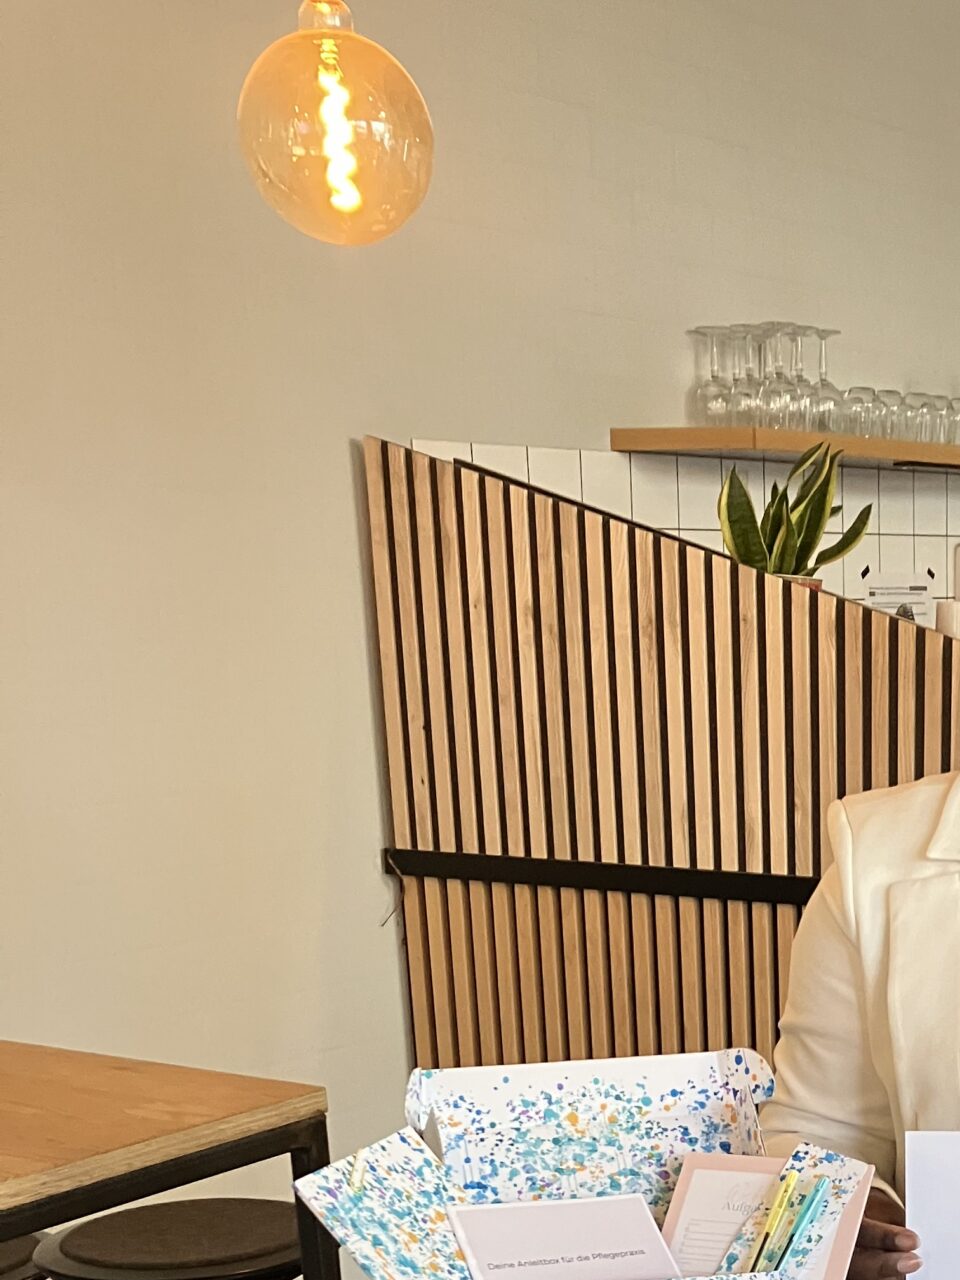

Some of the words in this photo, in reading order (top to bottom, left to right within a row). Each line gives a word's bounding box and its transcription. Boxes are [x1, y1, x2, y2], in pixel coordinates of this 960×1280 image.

[487, 1262, 516, 1271] Deine
[517, 1258, 560, 1267] Anleitbox
[560, 1256, 575, 1264] für
[576, 1254, 591, 1262] die
[591, 1249, 646, 1260] Pflegepraxis
